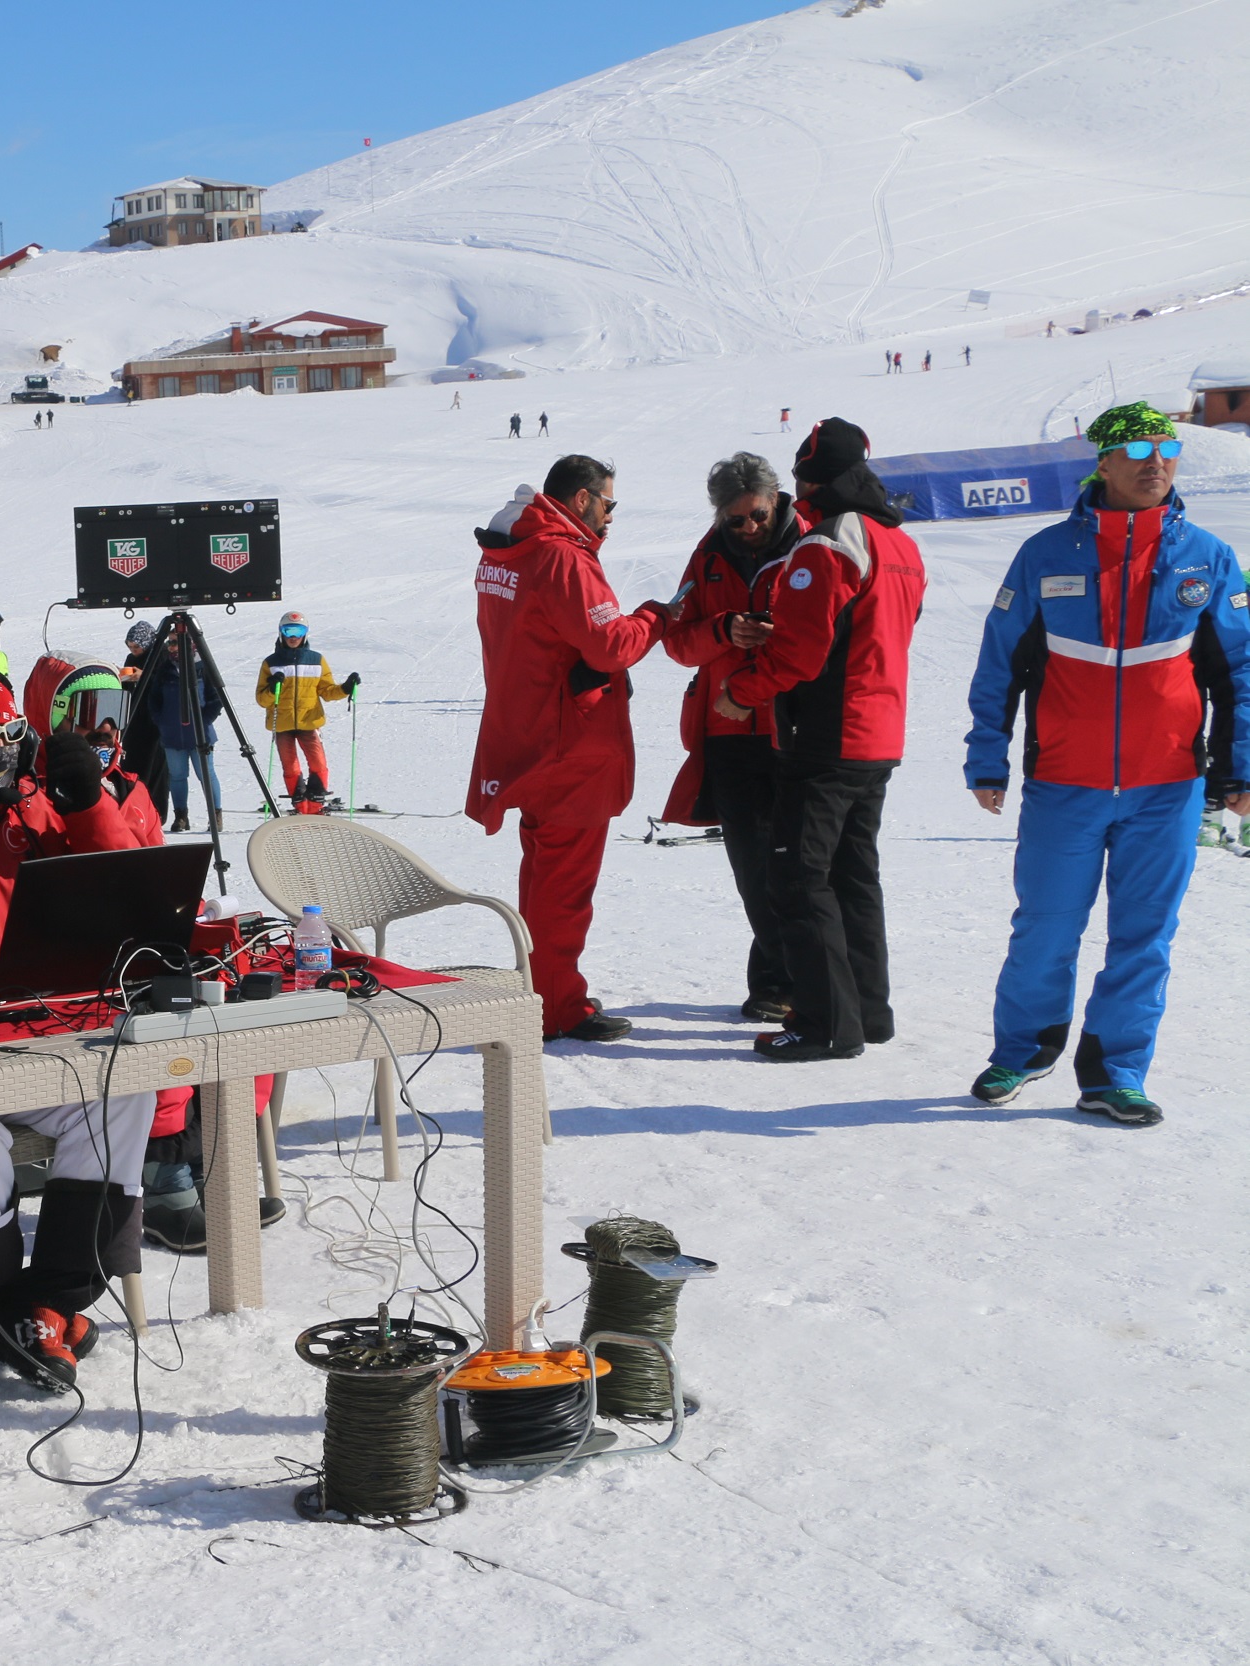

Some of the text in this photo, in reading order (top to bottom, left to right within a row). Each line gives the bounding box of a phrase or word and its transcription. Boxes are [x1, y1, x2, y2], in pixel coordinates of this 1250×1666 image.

[966, 486, 1026, 507] AFAD
[114, 541, 141, 557] TAG
[216, 537, 243, 552] TAG
[111, 558, 145, 575] HEUER
[213, 553, 248, 570] HEUER
